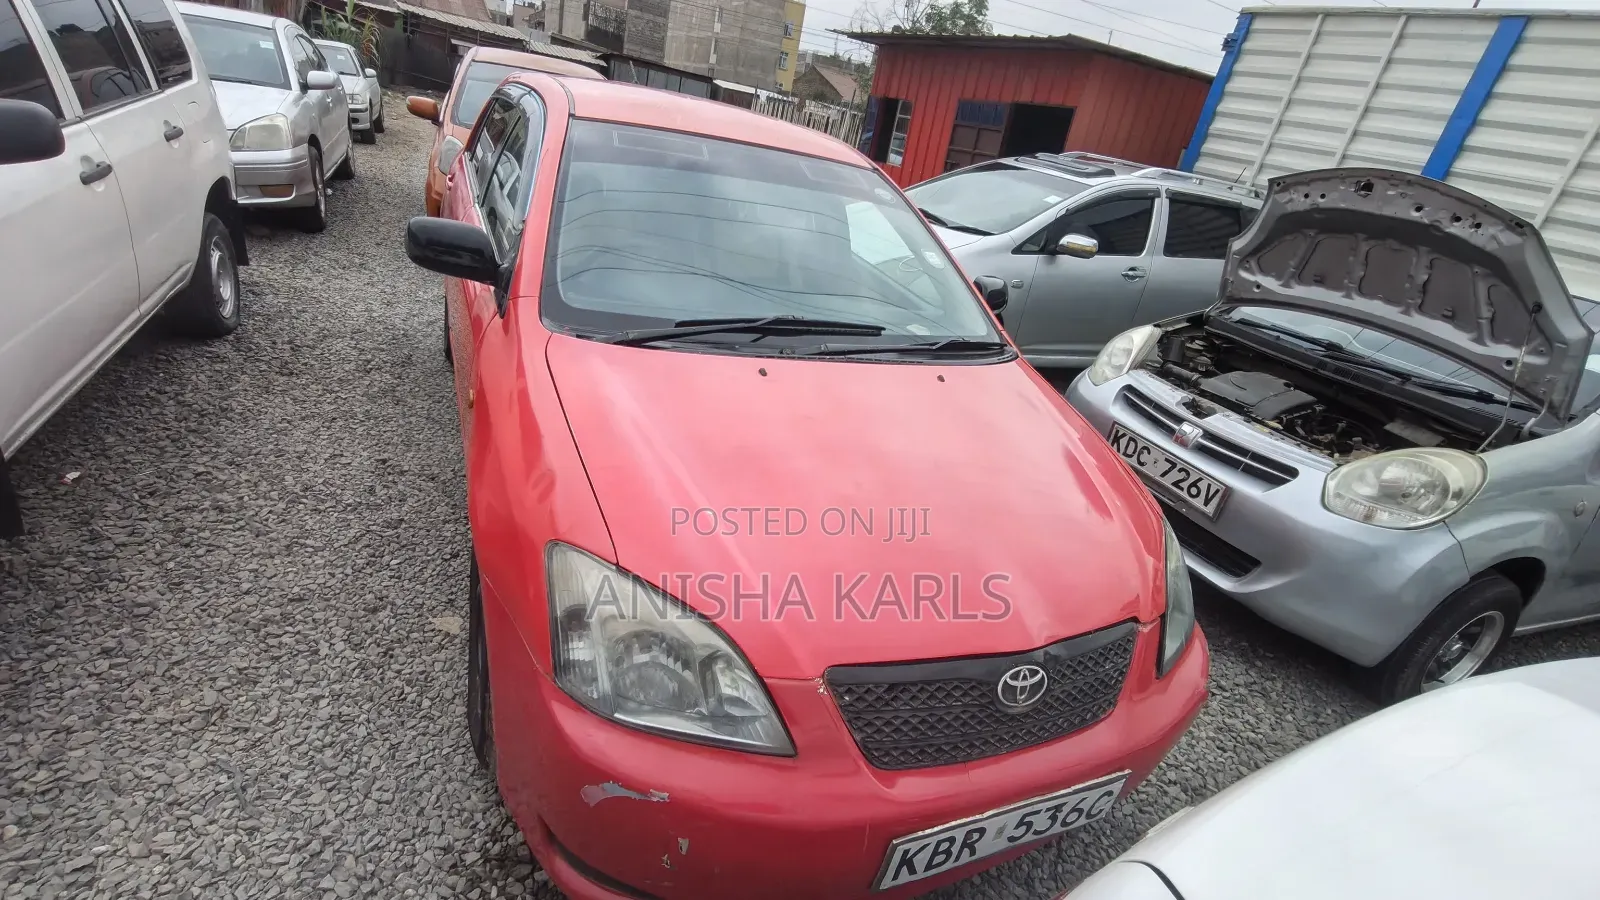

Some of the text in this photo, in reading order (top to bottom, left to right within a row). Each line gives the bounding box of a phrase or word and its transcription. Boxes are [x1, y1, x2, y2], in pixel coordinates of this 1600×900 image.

[1110, 430, 1220, 507] KDC 726V
[891, 826, 987, 882] KBR
